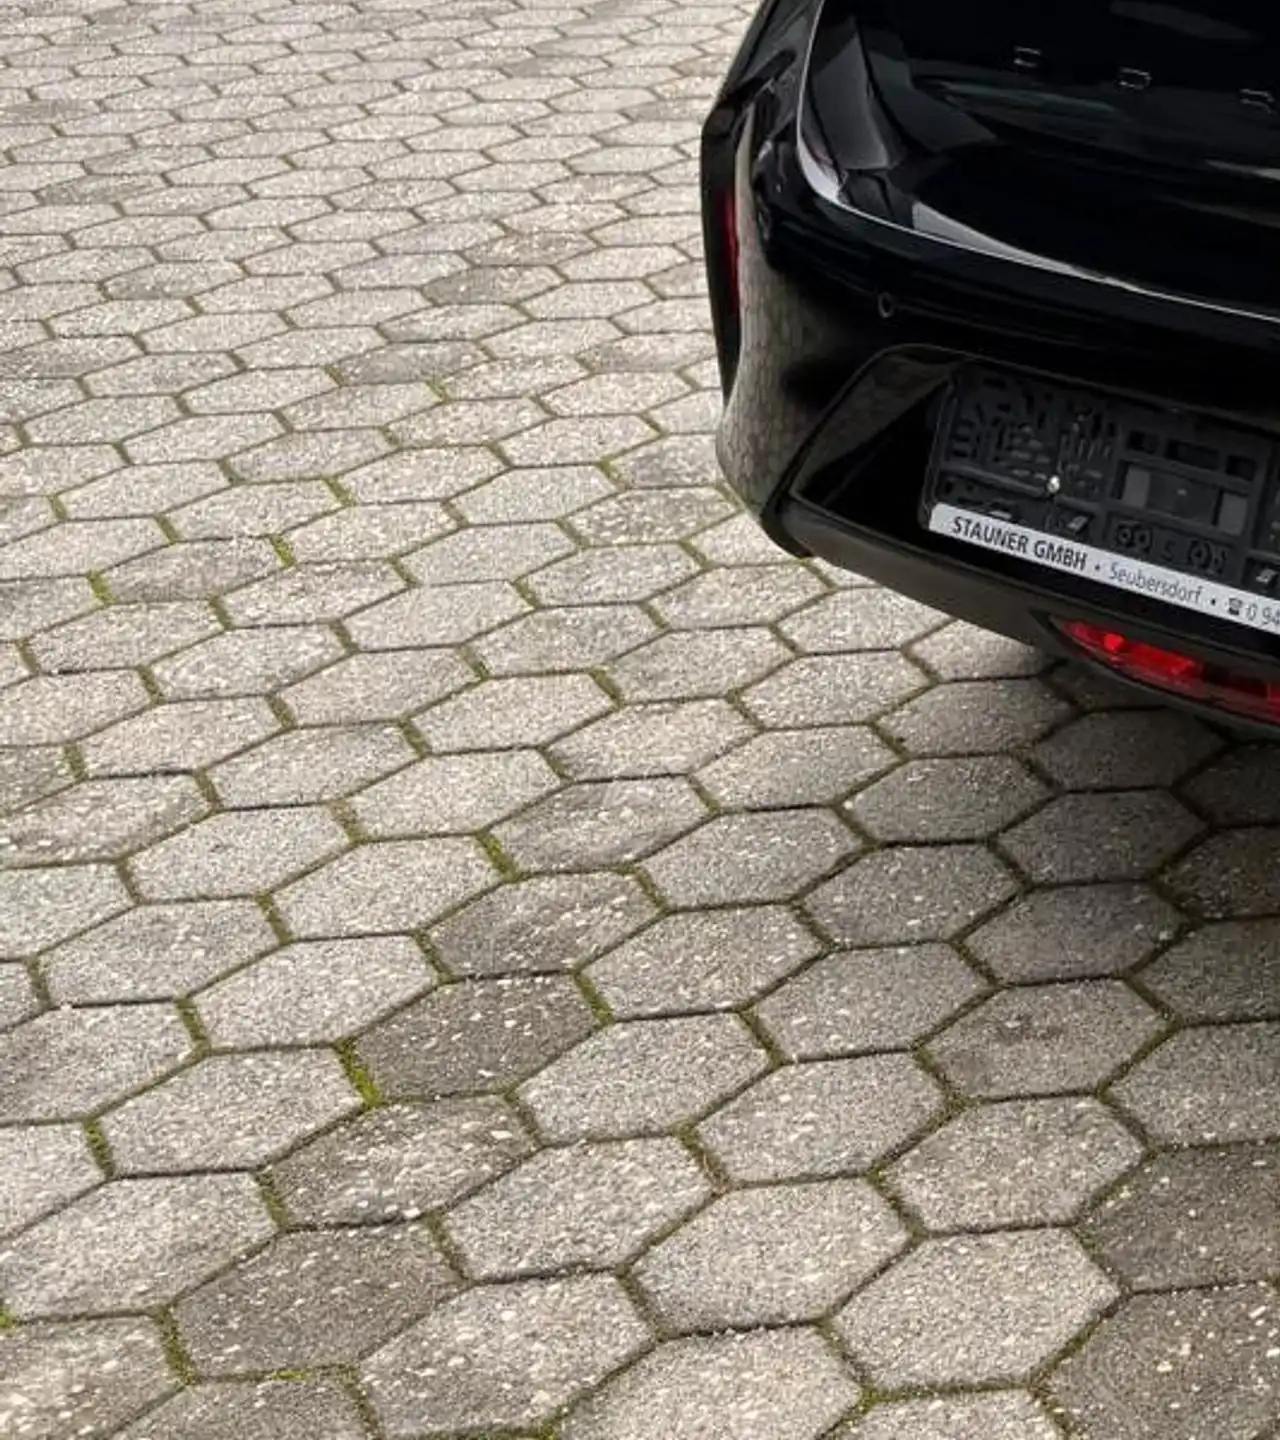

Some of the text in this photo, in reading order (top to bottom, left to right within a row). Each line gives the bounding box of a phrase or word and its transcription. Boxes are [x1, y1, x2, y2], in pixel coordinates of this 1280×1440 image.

[952, 516, 1028, 553] STAUNER
[1034, 540, 1088, 570] GMBH
[1109, 562, 1203, 604] Seubersdorf
